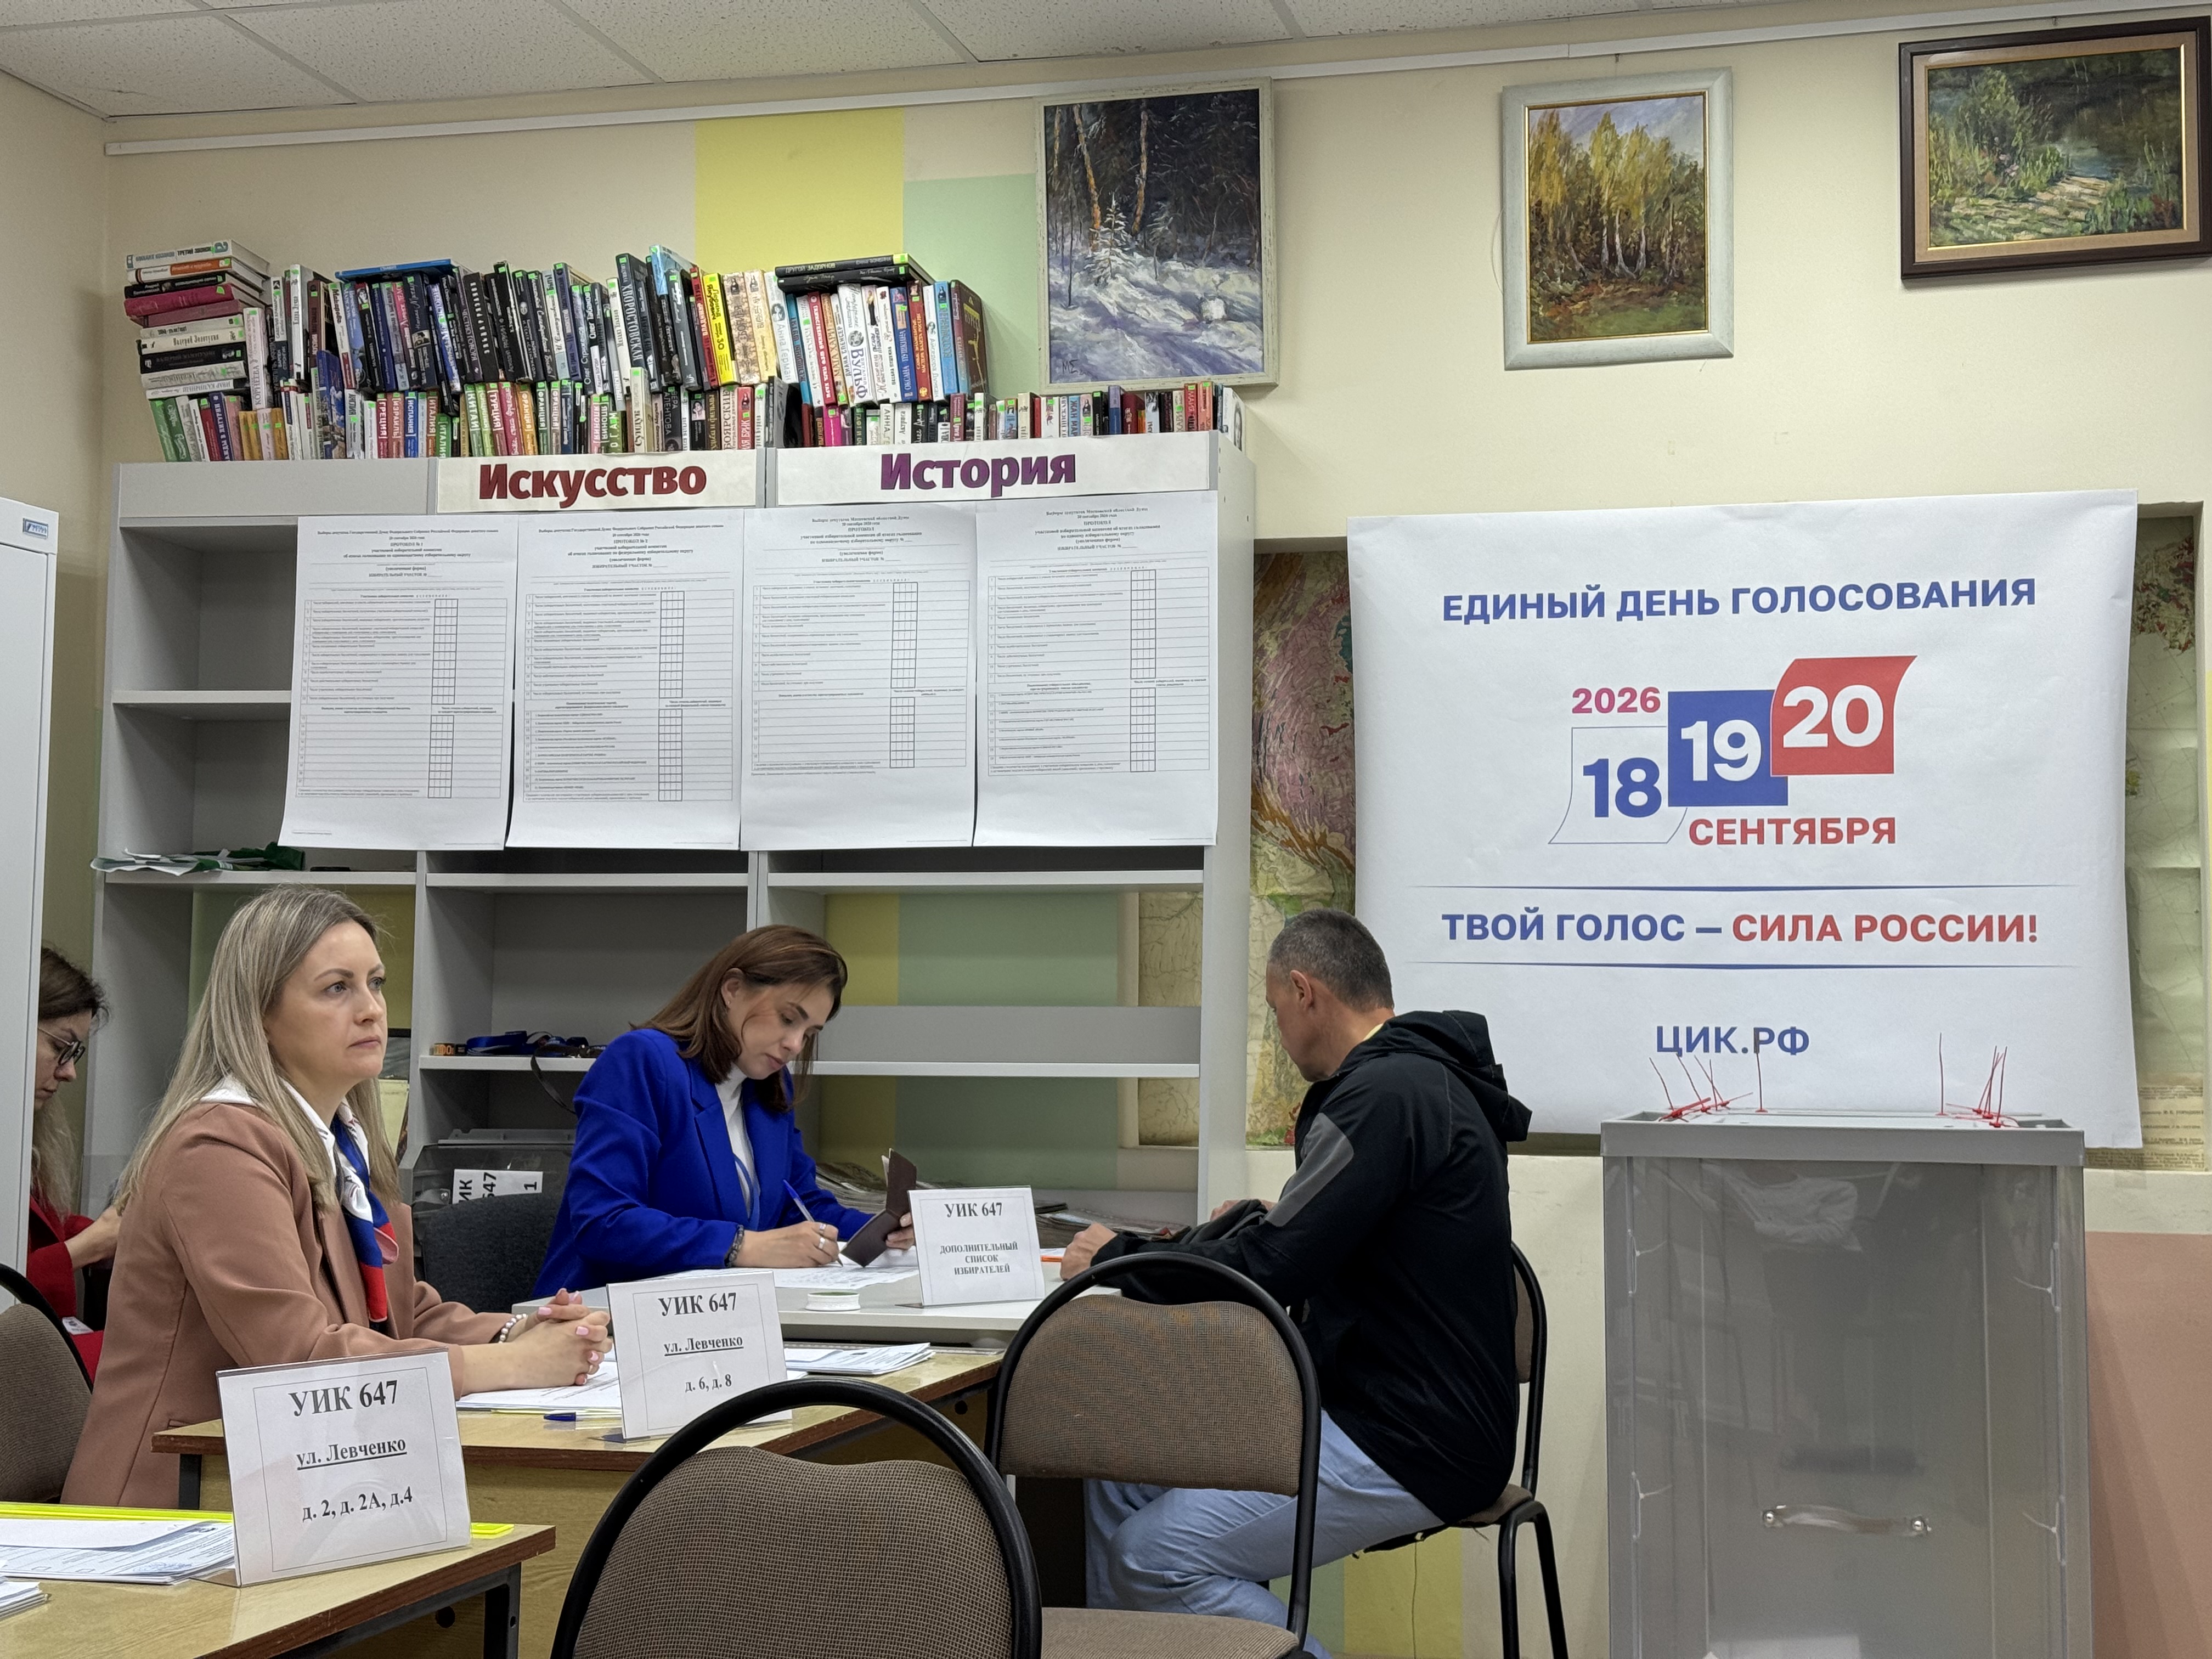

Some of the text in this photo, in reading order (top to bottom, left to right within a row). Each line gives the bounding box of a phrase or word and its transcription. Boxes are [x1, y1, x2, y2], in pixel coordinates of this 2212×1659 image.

[588, 322, 597, 339] Олег
[620, 284, 644, 362] ХВОРОСТОВСКАЯ
[902, 364, 912, 391] ОКСАНА
[1188, 390, 1196, 413] МАЙЯ
[722, 388, 732, 449] БОЯРСКИЕ
[740, 419, 750, 438] БРИК
[478, 463, 708, 507] Искусство
[881, 454, 1077, 499] История
[1444, 580, 2034, 623] ЕДИНЫЙ ДЕНЬ ГОЛОСОВАНИЯ
[1573, 688, 1660, 713] 2026
[1783, 685, 1883, 748] 20
[1681, 719, 1762, 781] 19
[1584, 758, 1662, 817] 18
[1690, 818, 1894, 845] СЕНТЯБРЯ
[1442, 906, 1545, 942] ТВОЙ
[1558, 916, 1683, 940] ГОЛОС
[1734, 915, 1840, 940] СИЛА
[1855, 915, 2035, 941] РОССИИ!
[1655, 1026, 1809, 1057] ЦИК.РФ
[459, 1180, 472, 1203] ИК
[524, 1181, 537, 1190] 1
[944, 1202, 1003, 1218] УИК 647
[939, 1241, 1018, 1254] ДОПОЛНИТЕЛЬНЫЙ
[965, 1254, 998, 1263] СПИСОК
[954, 1263, 1011, 1275] ИЗБИРАТЕЛЕЙ
[658, 1293, 737, 1317] УИК 647
[663, 1336, 743, 1354] ул. Левченко
[685, 1374, 732, 1392] д. 6, д. 8
[289, 1379, 398, 1417] УИК 647
[296, 1438, 408, 1468] ул. Левченко
[302, 1486, 414, 1522] д. 2, д. 2А, д.4
